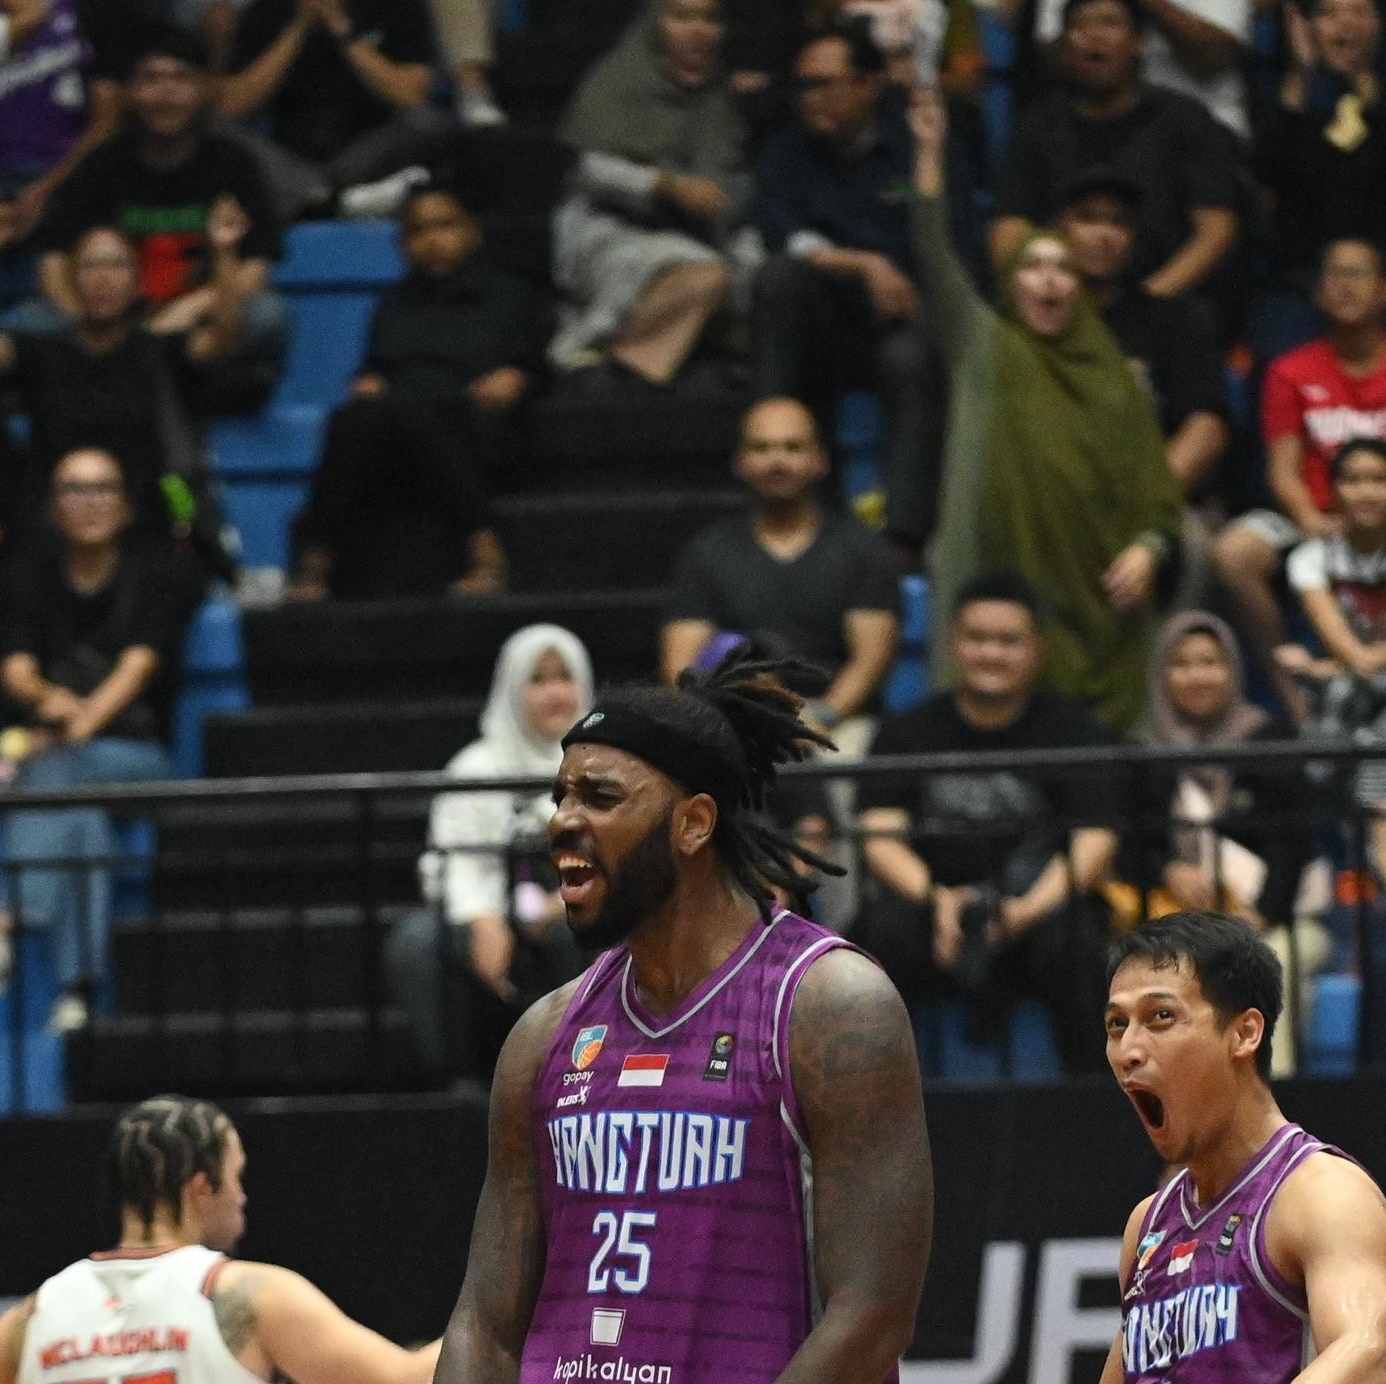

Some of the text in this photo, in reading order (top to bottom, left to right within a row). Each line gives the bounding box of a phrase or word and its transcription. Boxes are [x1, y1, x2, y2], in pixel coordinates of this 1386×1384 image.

[709, 1060, 727, 1070] FIBA
[563, 1071, 594, 1086] gopay
[587, 1210, 657, 1294] 25
